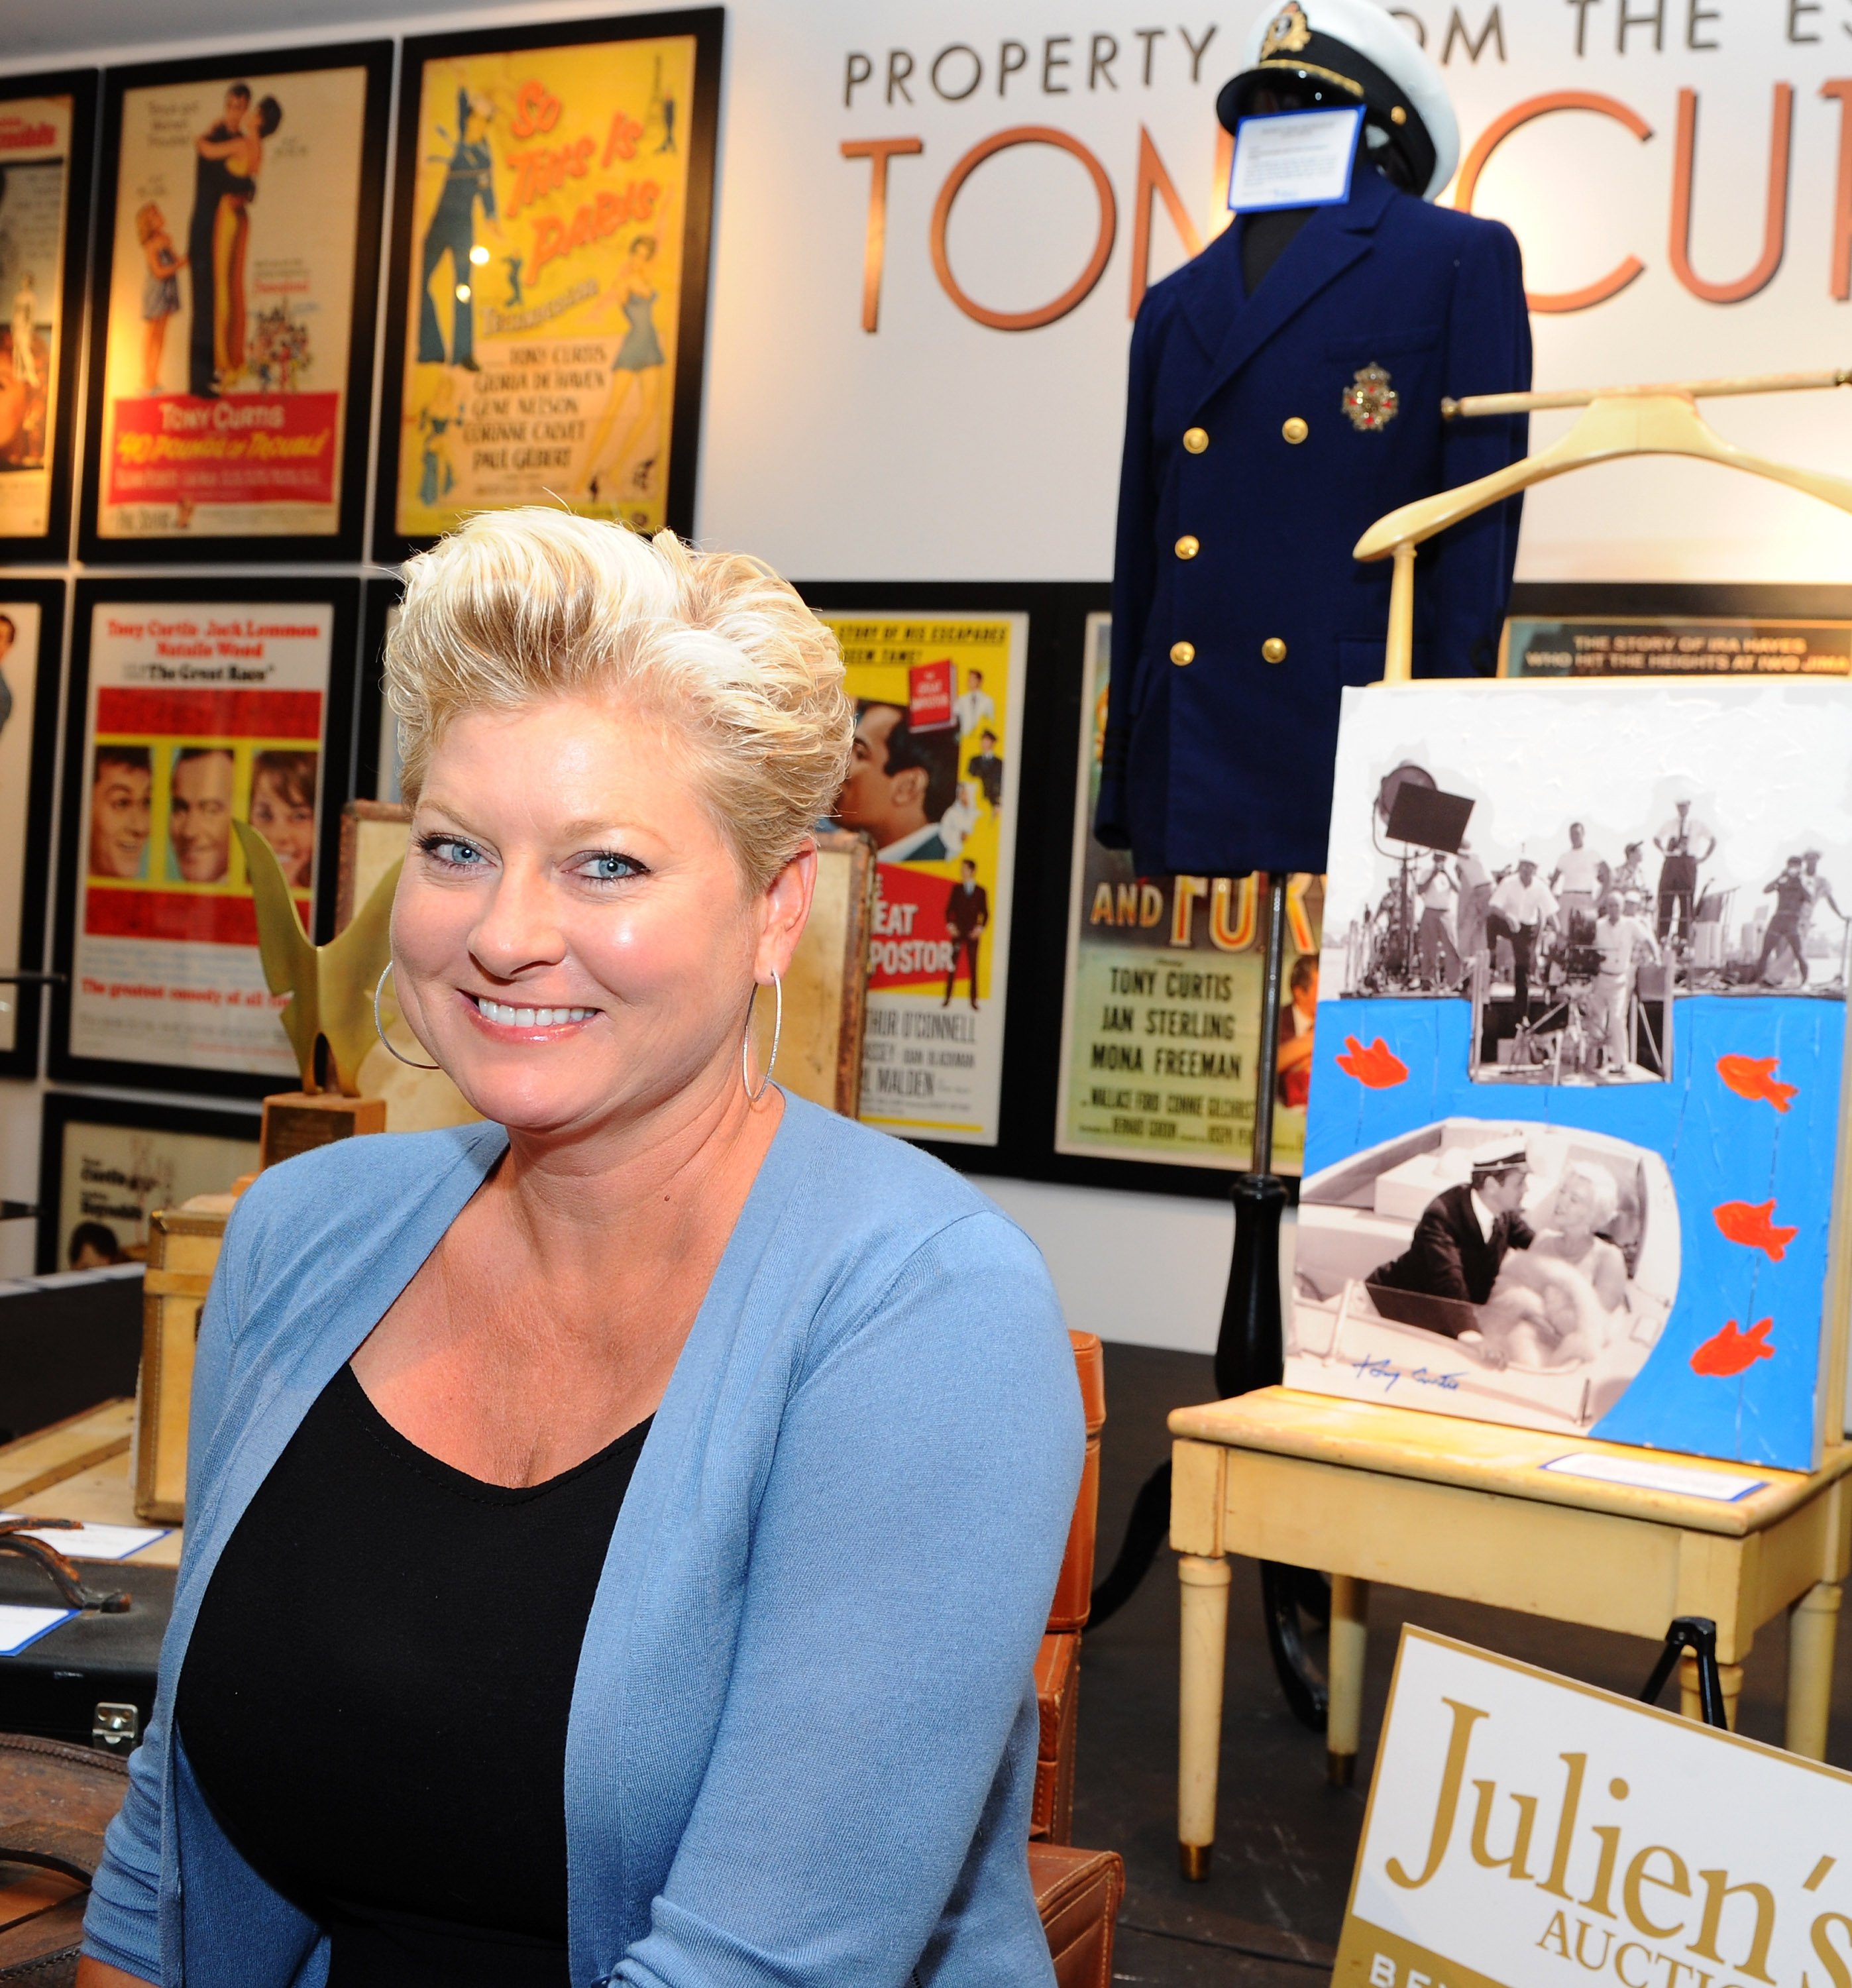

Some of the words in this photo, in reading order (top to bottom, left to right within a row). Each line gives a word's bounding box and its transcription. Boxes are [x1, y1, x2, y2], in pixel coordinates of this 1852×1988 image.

[843, 24, 1219, 109] PROPERTY
[1568, 0, 1721, 58] THE
[523, 179, 661, 286] PARIS
[840, 122, 1234, 333] TON
[510, 347, 546, 366] TONY
[551, 343, 608, 363] CURTIS
[474, 371, 527, 394] GLORIA
[555, 369, 604, 389] HAVEN
[472, 449, 508, 471] PAUL
[148, 620, 197, 637] Curtis
[1574, 634, 1611, 652] THE
[1612, 634, 1676, 653] STORY
[1678, 635, 1706, 653] OF
[1525, 651, 1573, 669] WHO
[871, 901, 919, 936] EAT
[1090, 881, 1164, 928] AND
[869, 940, 956, 976] POSTOR
[81, 975, 105, 995] The
[109, 981, 164, 1001] greatest
[1110, 967, 1158, 995] TONY
[1166, 971, 1233, 1003] CURTIS
[1101, 1004, 1134, 1033] JAN
[1144, 1007, 1236, 1042] STERLING
[1090, 1042, 1144, 1075] MONA
[1154, 1047, 1241, 1081] FREEMAN
[1385, 1696, 1852, 1988] Julien's
[1535, 1909, 1753, 1988] AUCTI
